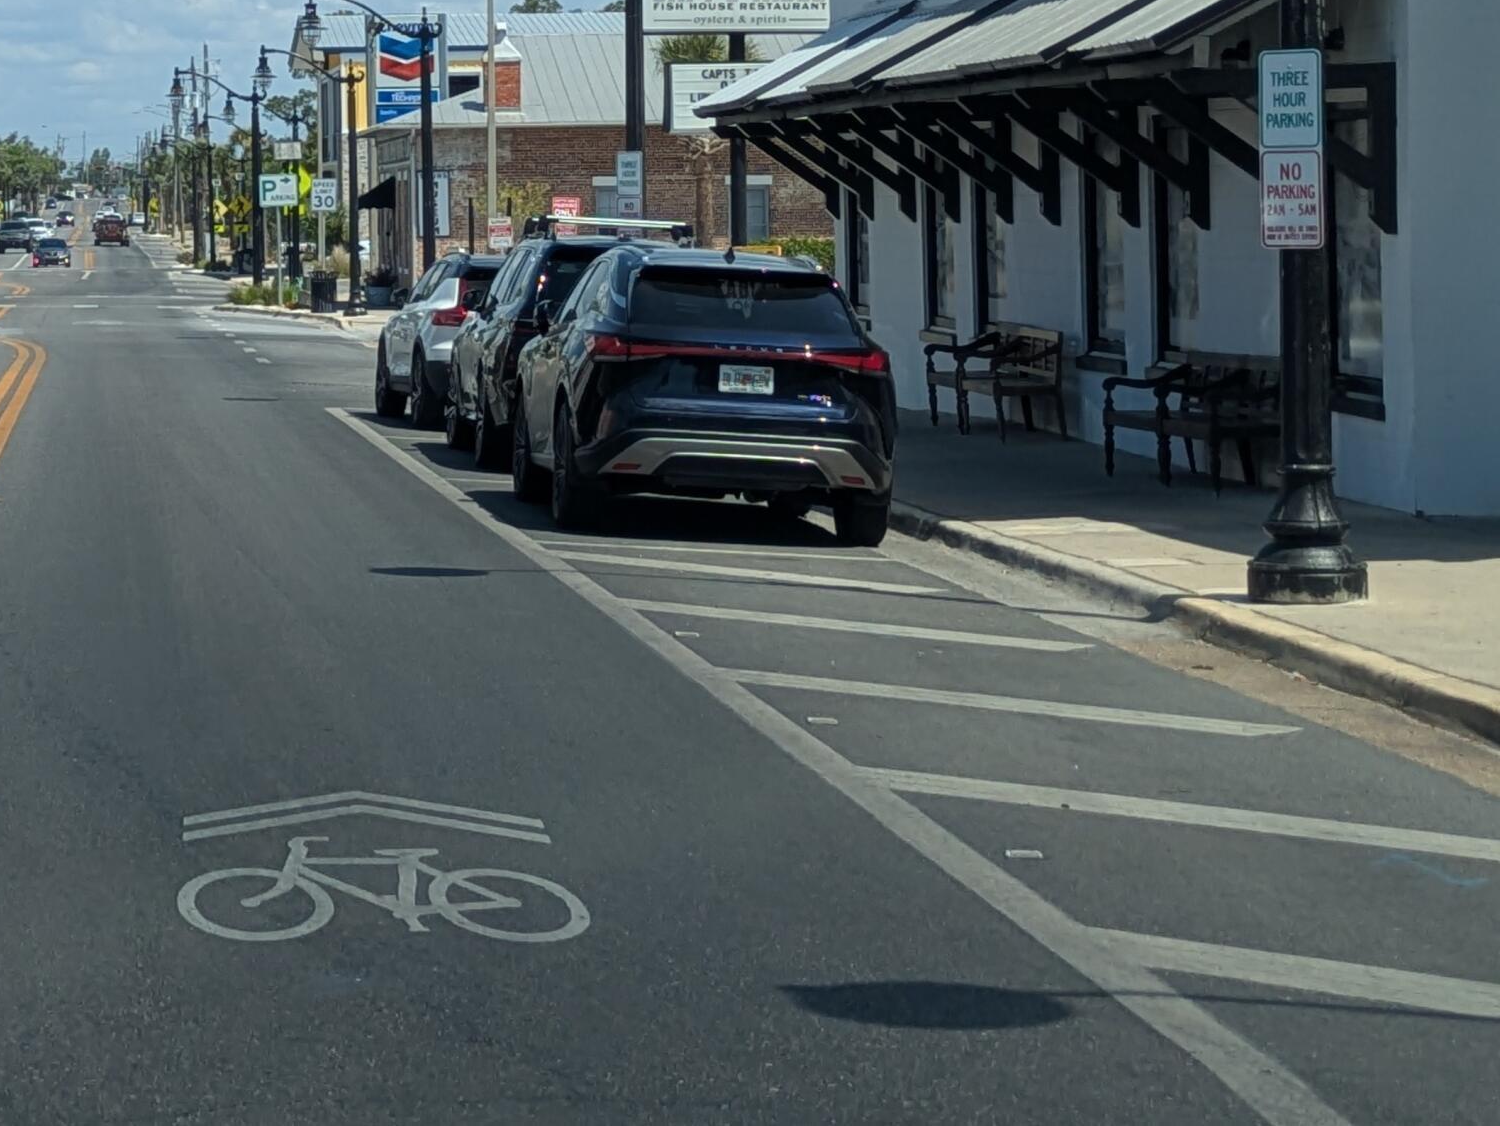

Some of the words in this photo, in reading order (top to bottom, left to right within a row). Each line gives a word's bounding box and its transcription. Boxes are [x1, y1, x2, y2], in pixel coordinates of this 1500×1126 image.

[653, 2, 684, 10] FISH
[689, 2, 734, 10] HOUSE
[740, 2, 827, 10] RESTAURANT
[693, 15, 734, 25] oysters
[739, 14, 747, 23] &
[750, 15, 787, 25] spirits
[701, 69, 736, 79] CAPTS
[1270, 71, 1308, 87] THREE
[1273, 92, 1306, 107] HOUR
[1266, 112, 1314, 128] PARKING
[1280, 162, 1302, 180] NO
[1266, 184, 1315, 200] PARKING
[314, 195, 334, 208] 30
[624, 202, 634, 210] NO
[1267, 204, 1286, 216] 2AM
[1298, 204, 1316, 216] 5AM
